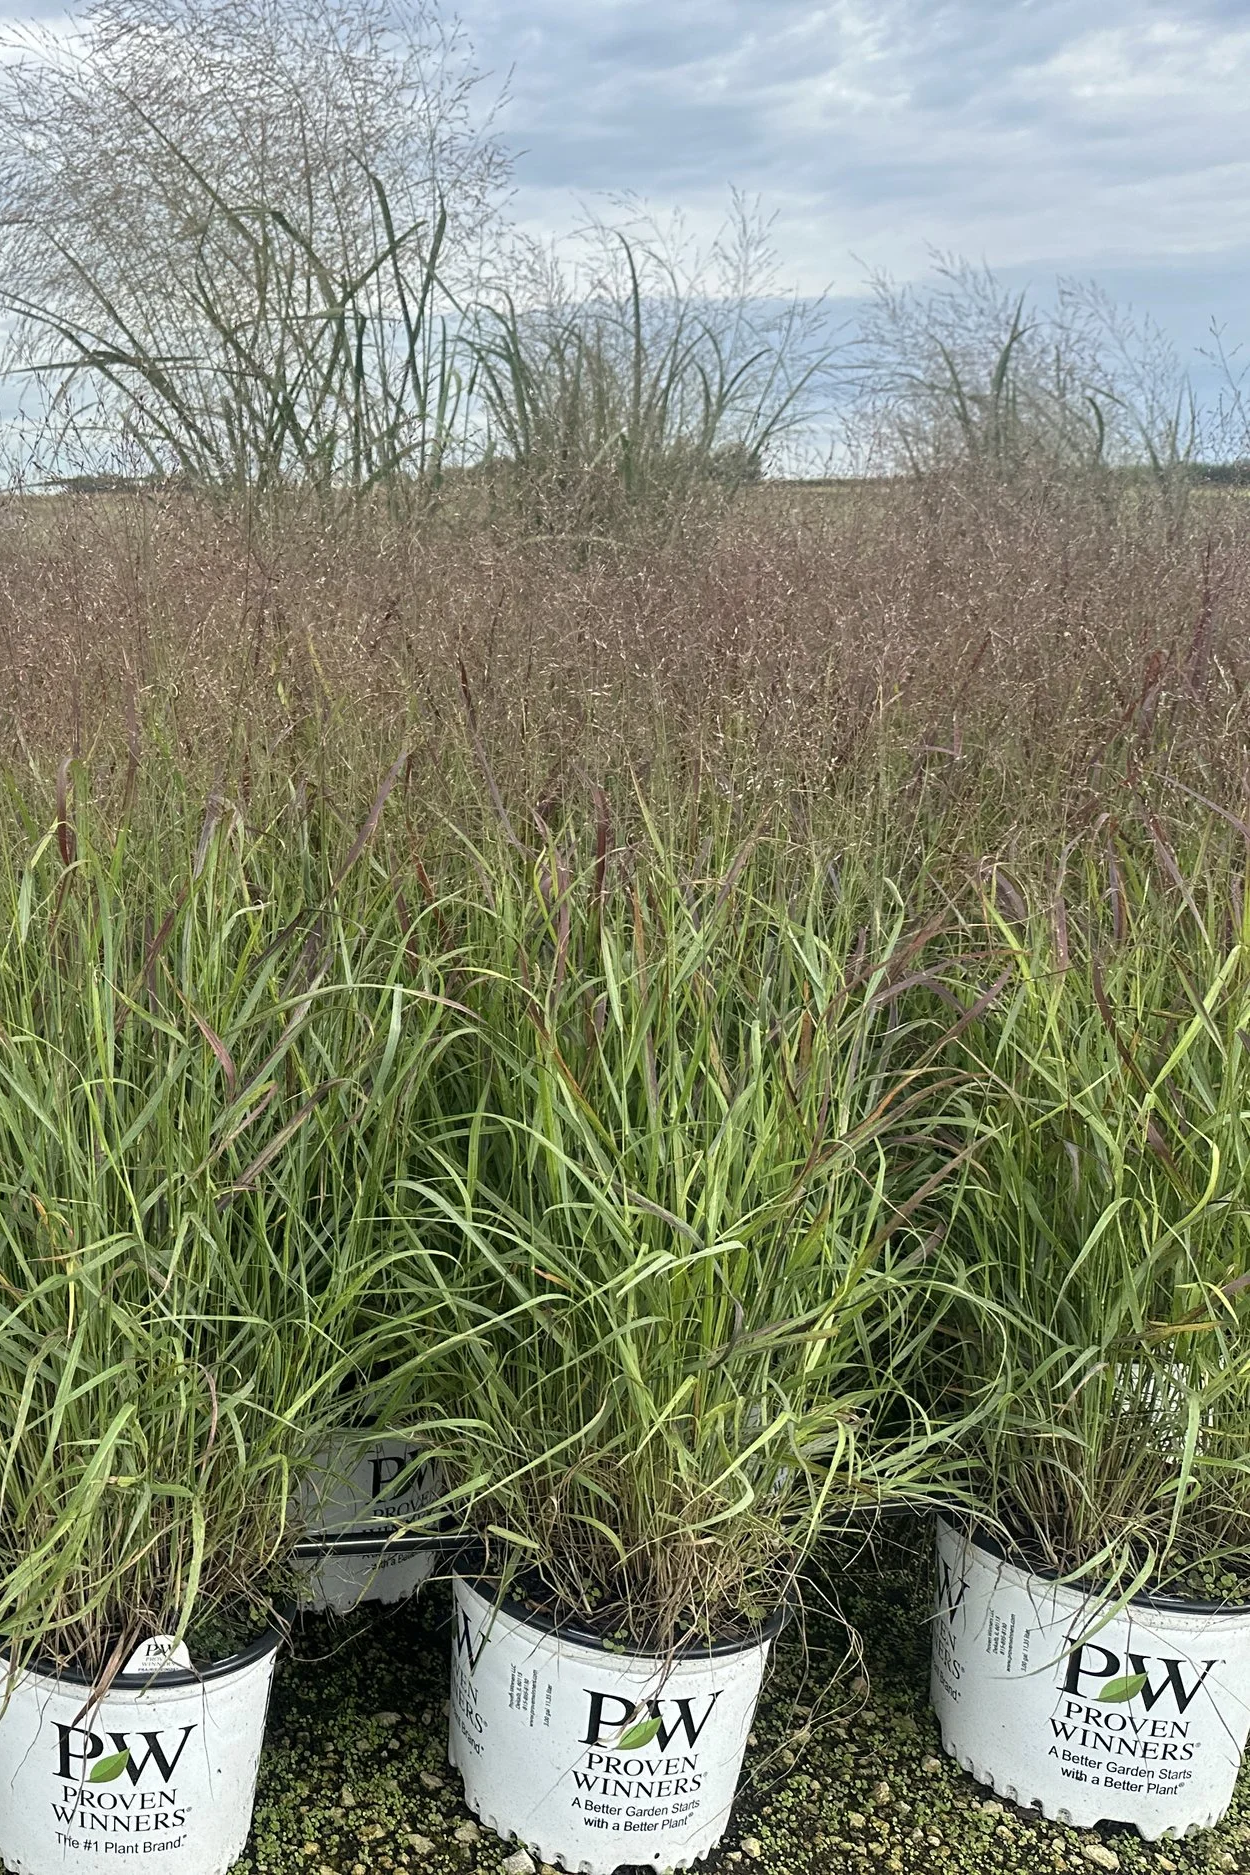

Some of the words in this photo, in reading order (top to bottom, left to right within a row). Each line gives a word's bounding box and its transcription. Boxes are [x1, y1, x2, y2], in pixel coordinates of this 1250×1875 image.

[1056, 1635, 1219, 1715] PW
[578, 1689, 724, 1753] PW
[1064, 1700, 1191, 1738] PROVEN
[50, 1721, 198, 1787] PW
[586, 1752, 700, 1777] PROVEN
[1048, 1745, 1059, 1758] A
[1061, 1749, 1102, 1769] Better
[1106, 1762, 1155, 1779] Garden
[1158, 1768, 1192, 1780] Starts
[1061, 1766, 1087, 1782] with
[1091, 1775, 1100, 1785] a
[1104, 1777, 1144, 1793] Better
[62, 1785, 178, 1811] PROVEN
[571, 1796, 581, 1808] A
[584, 1799, 622, 1816] Better
[626, 1806, 668, 1817] Garden
[671, 1799, 700, 1814] Starts
[584, 1817, 608, 1829] with
[612, 1821, 620, 1831] a
[624, 1820, 659, 1832] Better
[55, 1831, 80, 1848] The
[83, 1839, 99, 1852] #1
[105, 1841, 139, 1854] Plant
